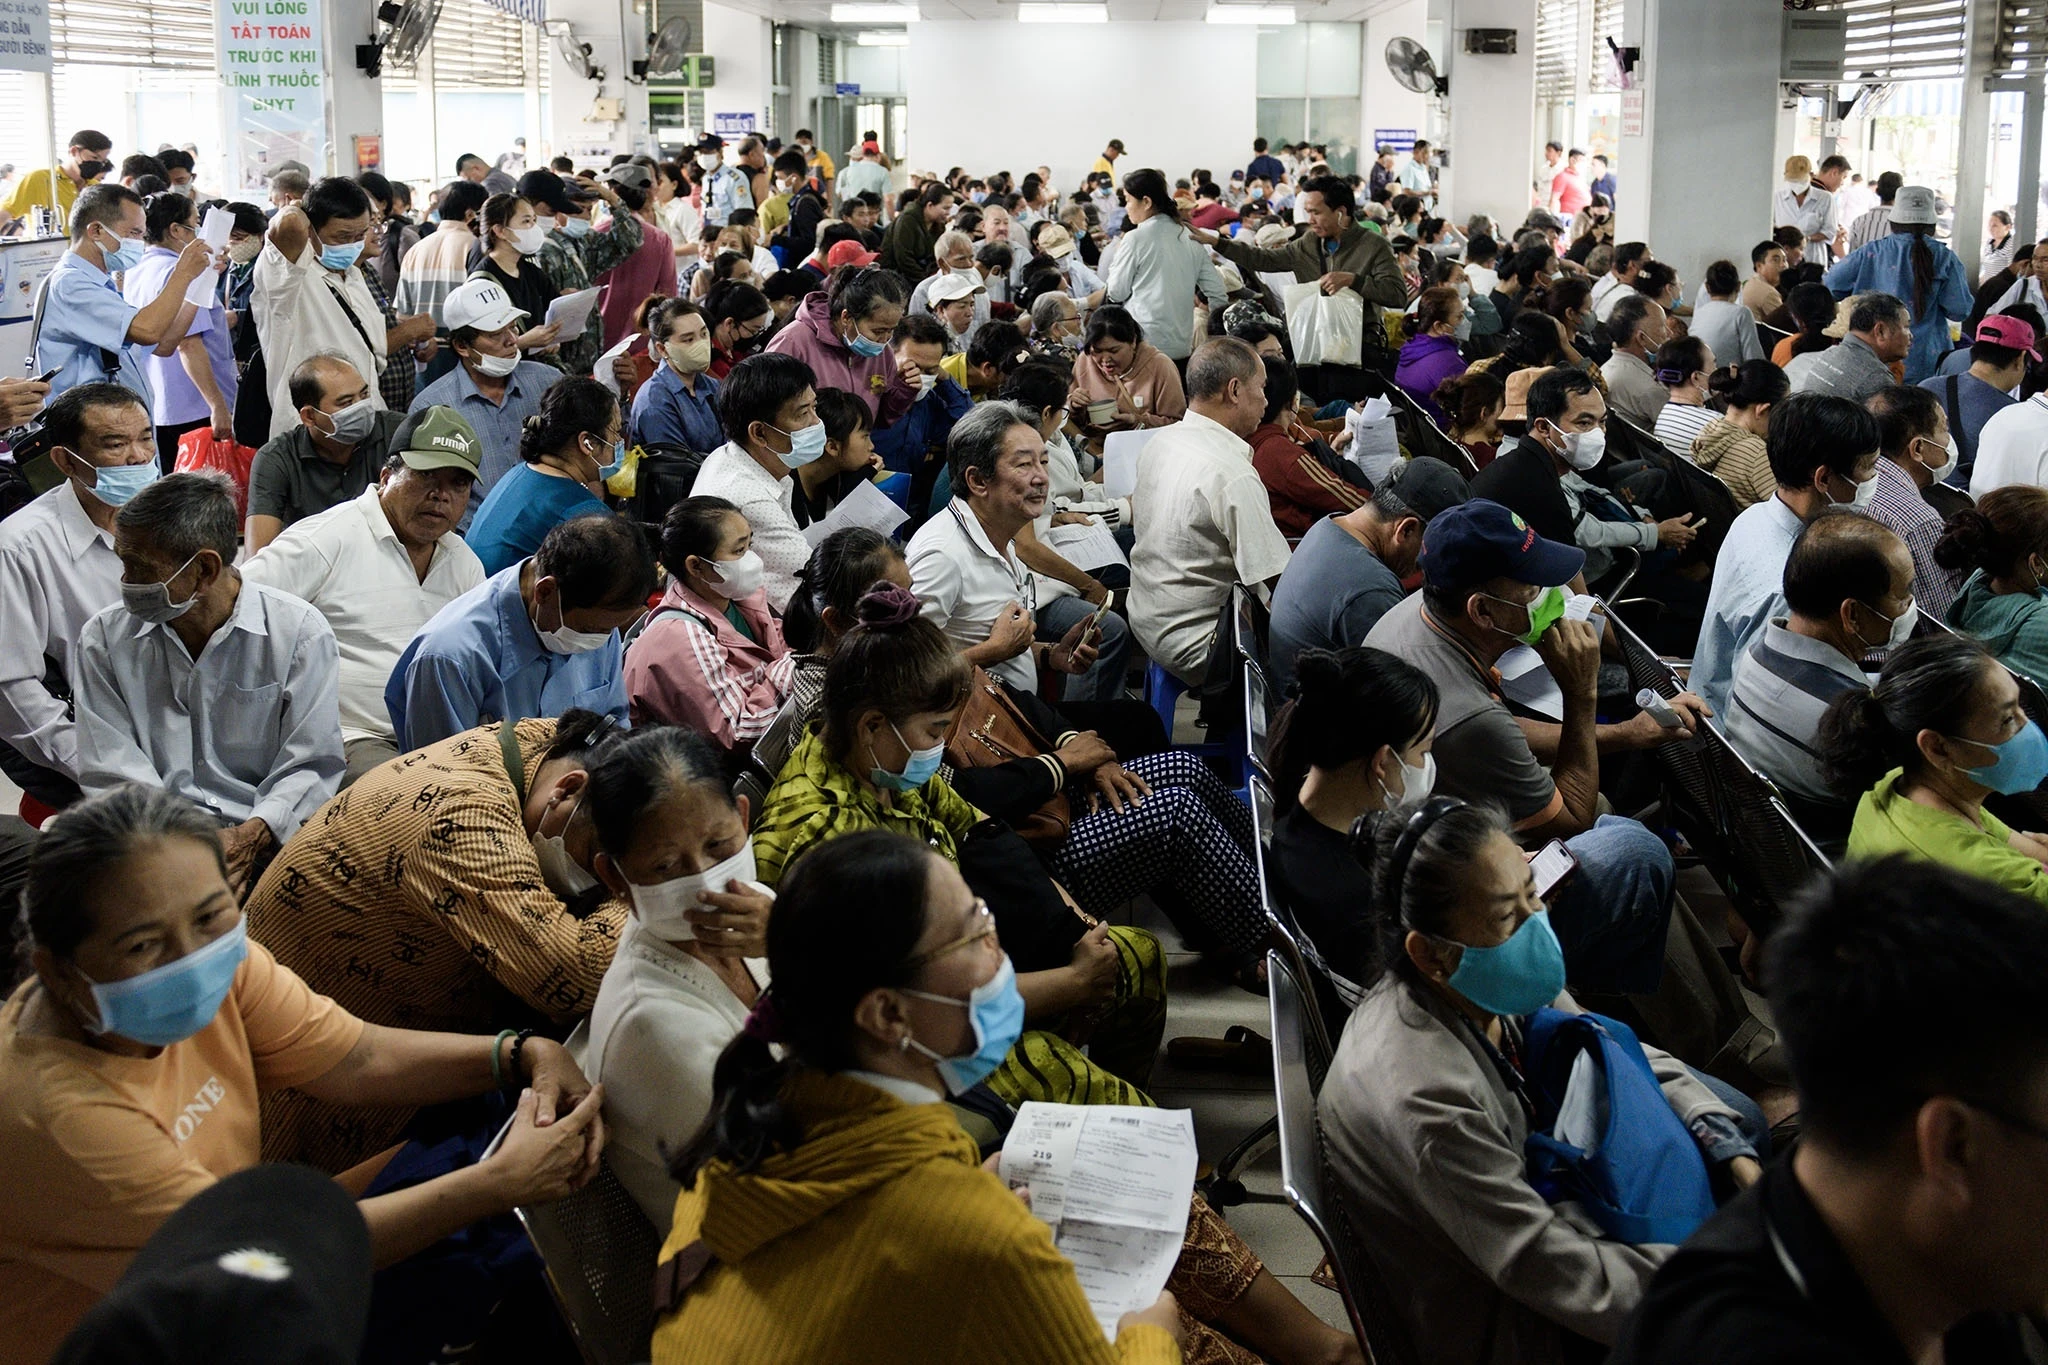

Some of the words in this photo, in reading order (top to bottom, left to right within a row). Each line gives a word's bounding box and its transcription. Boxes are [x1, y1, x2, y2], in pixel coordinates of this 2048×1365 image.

[232, 2, 259, 14] VUI
[267, 23, 311, 39] TOÁN
[227, 47, 284, 63] TRƯỚC
[290, 50, 316, 63] KHI
[226, 71, 261, 87] LĨNH
[267, 68, 320, 87] THUỐC
[252, 98, 295, 111] BHYT
[432, 436, 466, 452] PUMA
[174, 1076, 226, 1141] ONE
[1032, 1149, 1053, 1161] 219
